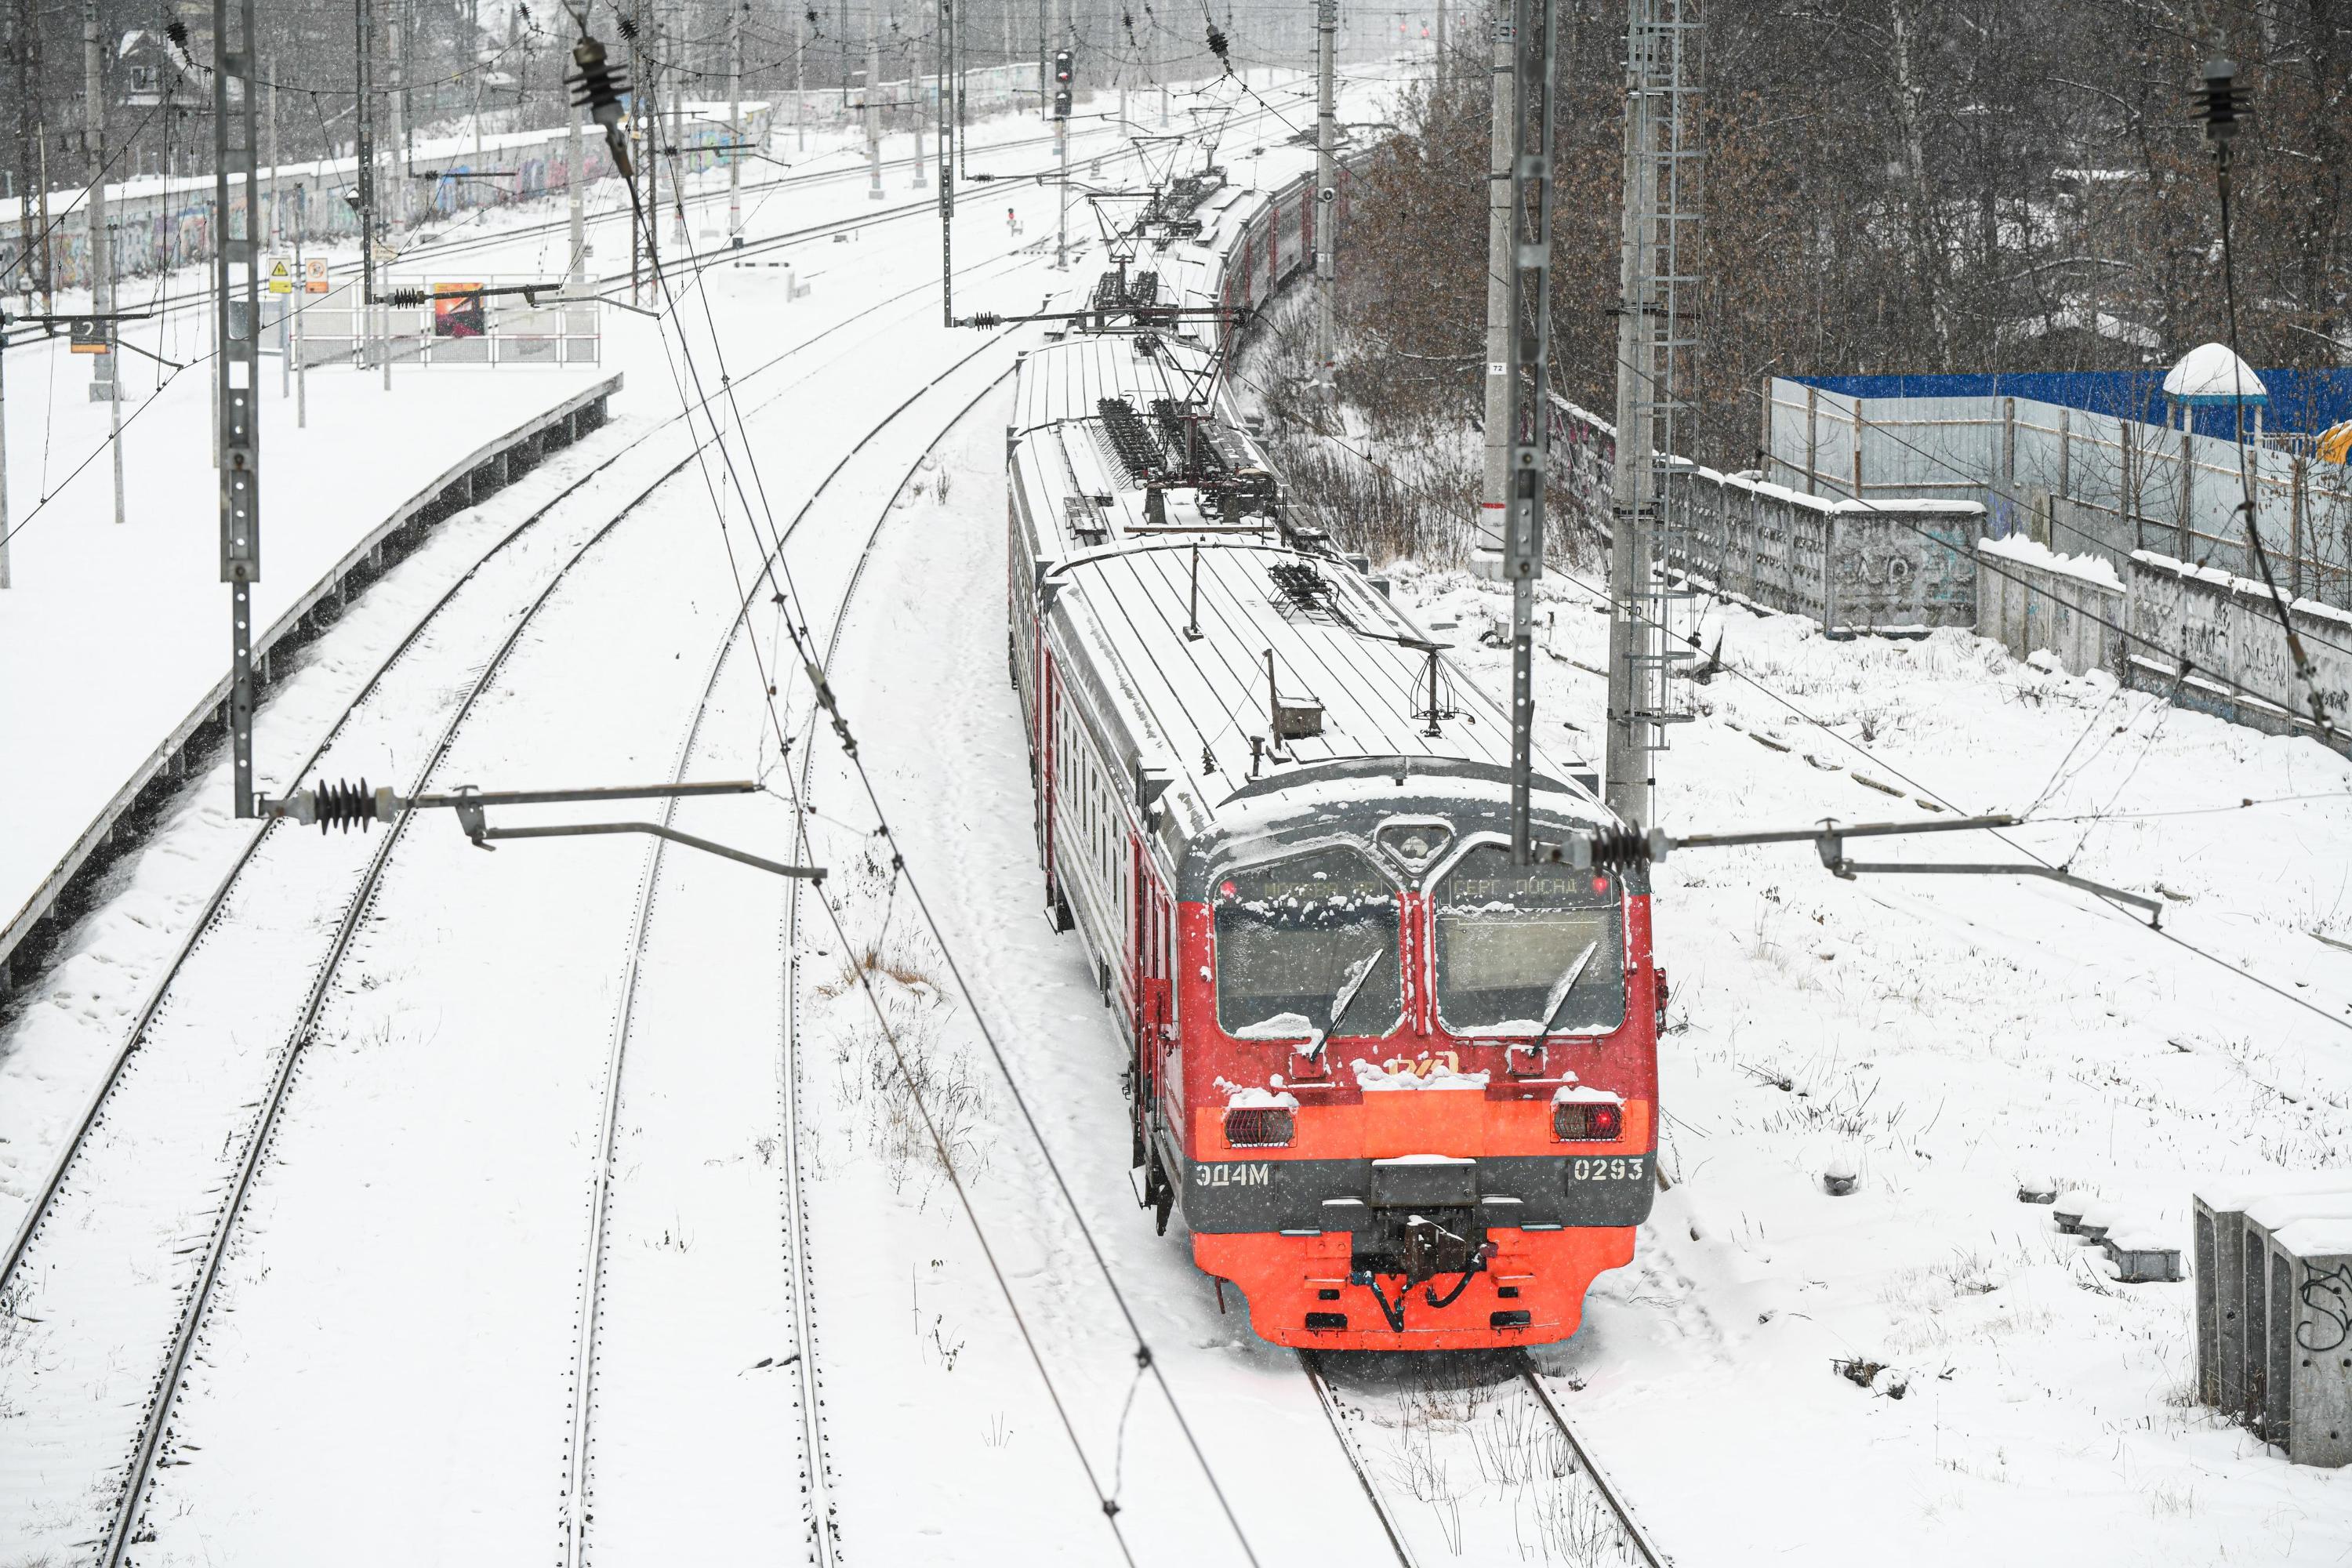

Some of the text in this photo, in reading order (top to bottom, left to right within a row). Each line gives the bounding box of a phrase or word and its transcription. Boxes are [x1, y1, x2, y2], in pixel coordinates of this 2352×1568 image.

[82, 321, 94, 340] 2
[1454, 878, 1577, 895] СЕРГ ПОСАД
[1196, 1163, 1269, 1186] ЭД4М
[1574, 1158, 1644, 1181] 0293
